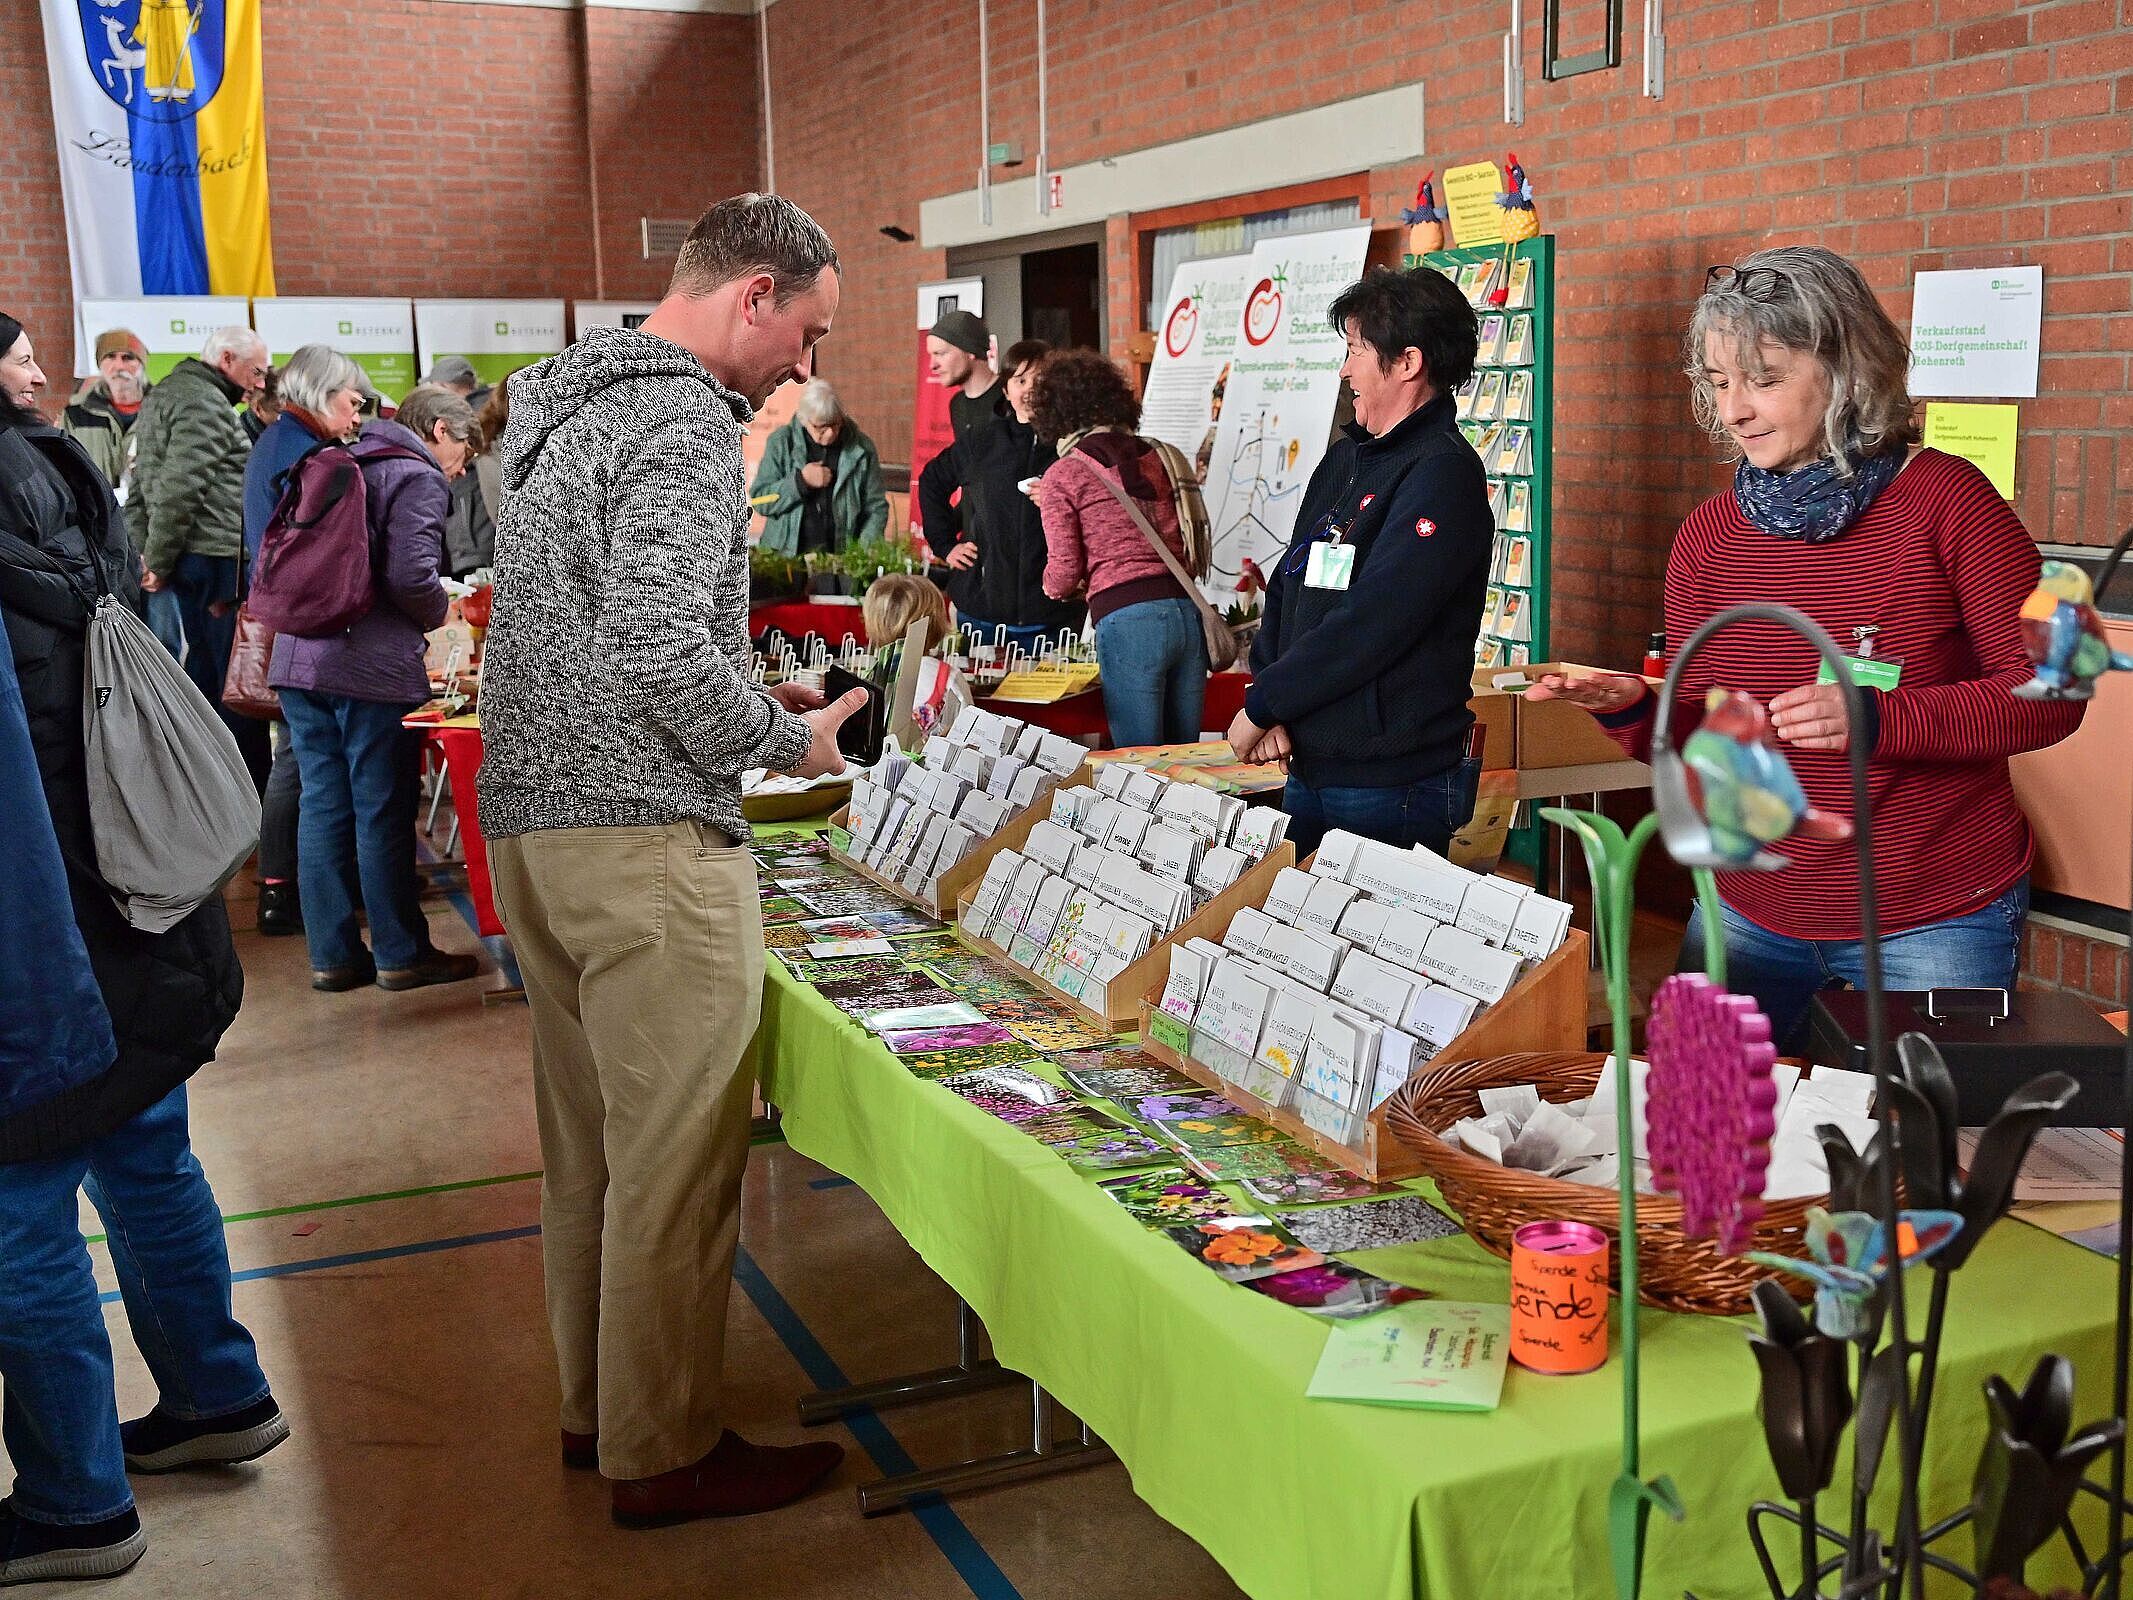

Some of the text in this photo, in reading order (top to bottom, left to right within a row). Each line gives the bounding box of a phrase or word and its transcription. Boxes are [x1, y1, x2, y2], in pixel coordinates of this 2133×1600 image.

[70, 130, 250, 176] Laudenbach
[1915, 324, 1986, 336] Verkaufsstand
[1913, 340, 2028, 353] SOS-Dorfgemeinschaft
[1914, 356, 1965, 366] Hohenroth
[1418, 894, 1456, 914] STROHBLUMEN
[1514, 928, 1539, 944] TAGETES
[1381, 938, 1413, 958] BARTNELKEN
[1460, 974, 1498, 995] FINGERHUT
[1414, 1020, 1435, 1036] KLEINE
[1531, 1259, 1578, 1278] Spende
[1519, 1329, 1564, 1352] Spende
